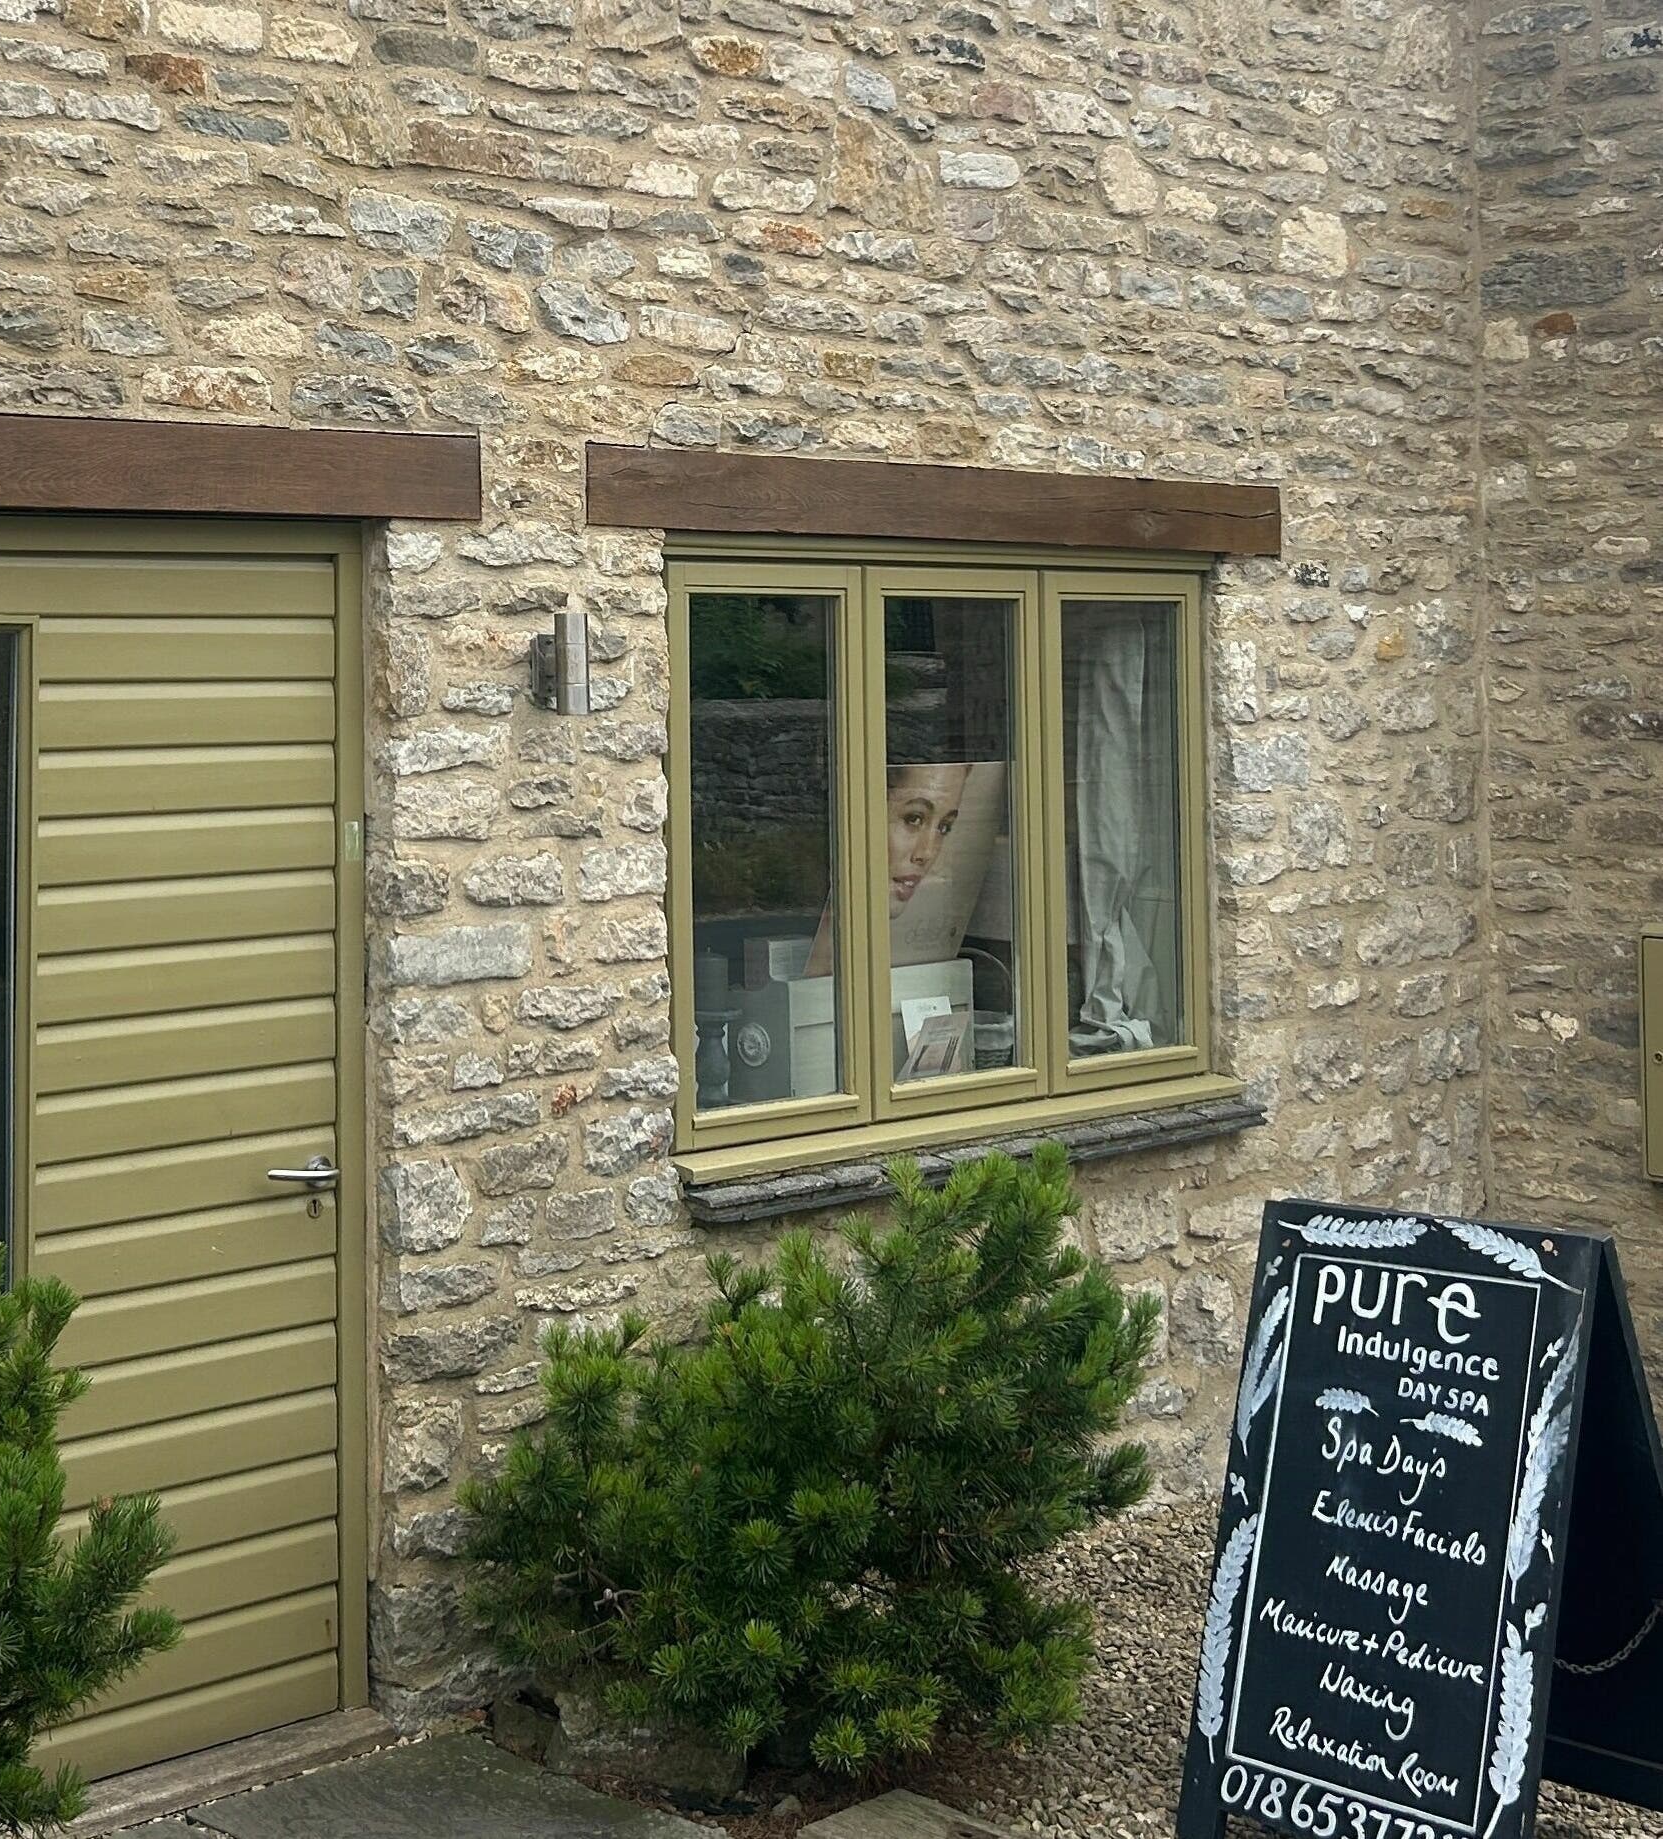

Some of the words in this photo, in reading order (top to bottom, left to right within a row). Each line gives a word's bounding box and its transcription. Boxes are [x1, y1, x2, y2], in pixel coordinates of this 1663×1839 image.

[1311, 1264, 1481, 1344] pure
[1337, 1325, 1500, 1381] Indulgence
[1398, 1377, 1442, 1405] DAY
[1443, 1388, 1489, 1416] SPA
[1322, 1416, 1373, 1473] Spa
[1376, 1434, 1447, 1506] Day's
[1311, 1490, 1398, 1537] Elemis
[1401, 1510, 1486, 1565] Facials
[1325, 1555, 1428, 1625] Massage
[1319, 1662, 1415, 1740] Waxing
[1269, 1706, 1395, 1780] Relaxation
[1397, 1752, 1460, 1798] Room
